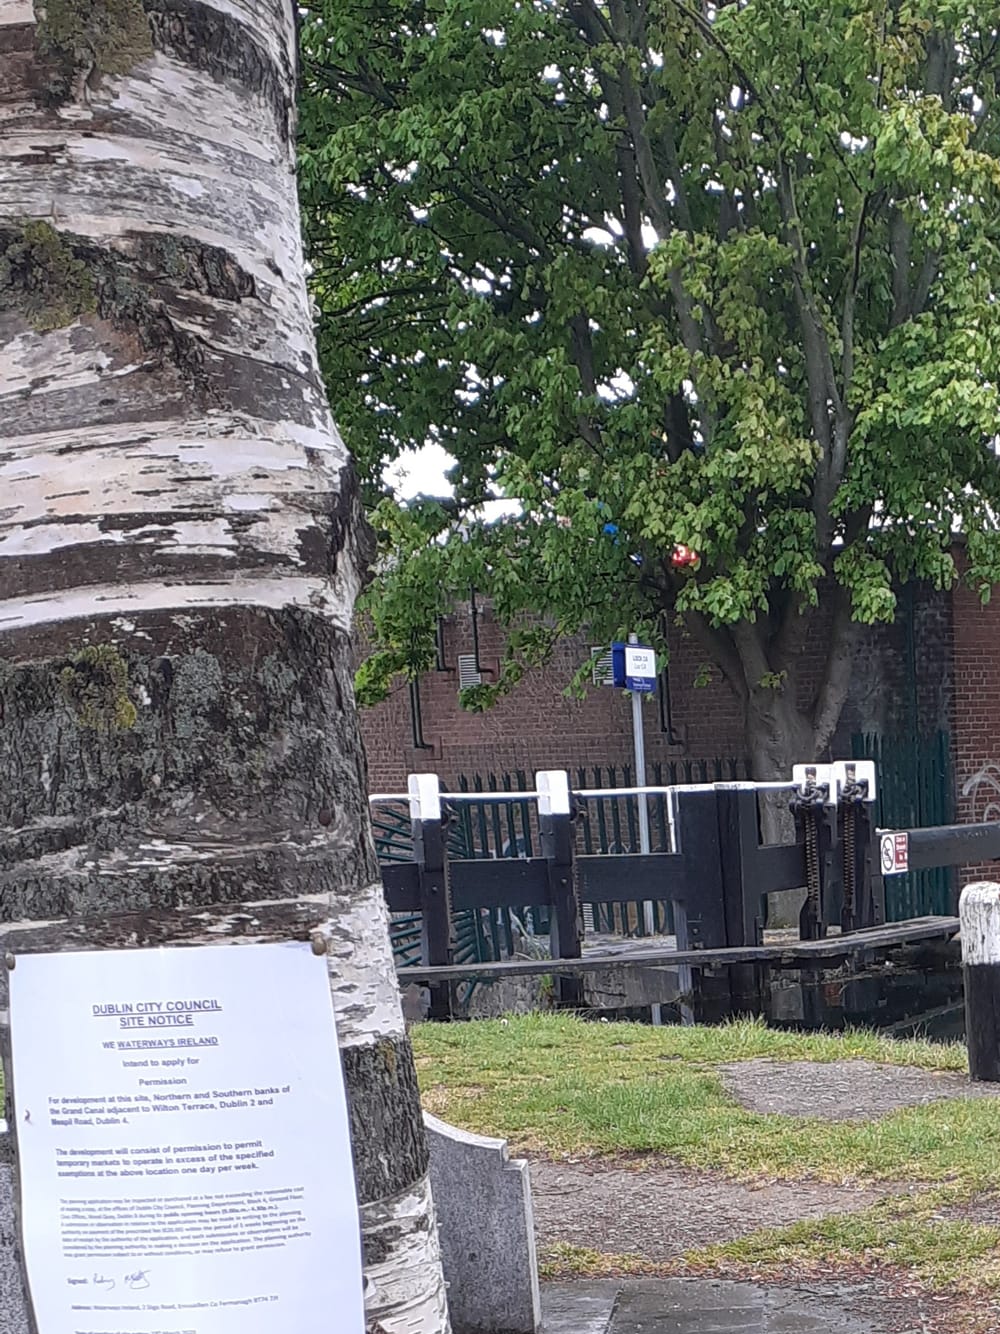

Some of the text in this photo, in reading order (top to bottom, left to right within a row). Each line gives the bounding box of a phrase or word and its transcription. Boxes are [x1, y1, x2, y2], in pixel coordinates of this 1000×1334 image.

[92, 999, 222, 1015] DUBLIN CITY COUNCIL
[120, 1014, 194, 1027] SITE NOTICE
[102, 1036, 218, 1049] WE WATERWAYS IRELAND
[150, 1058, 159, 1067] to
[161, 1057, 185, 1068] apply
[187, 1056, 200, 1065] for
[138, 1077, 187, 1087] Permission
[48, 1096, 59, 1105] For
[61, 1096, 107, 1106] development
[108, 1096, 116, 1104] at
[117, 1095, 132, 1103] this
[153, 1092, 192, 1102] Northern
[194, 1091, 210, 1100] and
[212, 1089, 253, 1099] Southern
[254, 1086, 280, 1096] banks
[281, 1085, 290, 1094] of
[61, 1107, 83, 1115] Grand
[84, 1106, 105, 1115] Canal
[106, 1106, 140, 1116] adjacent
[141, 1105, 150, 1113] to
[152, 1103, 180, 1113] Wilton
[219, 1099, 248, 1109] Dublin
[250, 1098, 256, 1107] 2
[257, 1097, 274, 1106] and
[96, 1117, 121, 1125] Dublin
[115, 1147, 128, 1155] will
[130, 1146, 160, 1155] consist
[162, 1145, 171, 1154] of
[172, 1143, 222, 1154] permission
[223, 1142, 233, 1150] to
[234, 1140, 262, 1150] permit
[122, 1158, 131, 1166] to
[132, 1157, 163, 1167] operate
[165, 1156, 174, 1164] in
[175, 1156, 206, 1165] excess
[208, 1153, 218, 1162] of
[219, 1152, 233, 1161] the
[235, 1149, 275, 1161] specified
[105, 1169, 118, 1177] the
[119, 1168, 144, 1177] above
[145, 1166, 179, 1176] location
[181, 1166, 198, 1174] one
[199, 1165, 216, 1175] day
[218, 1163, 233, 1174] per
